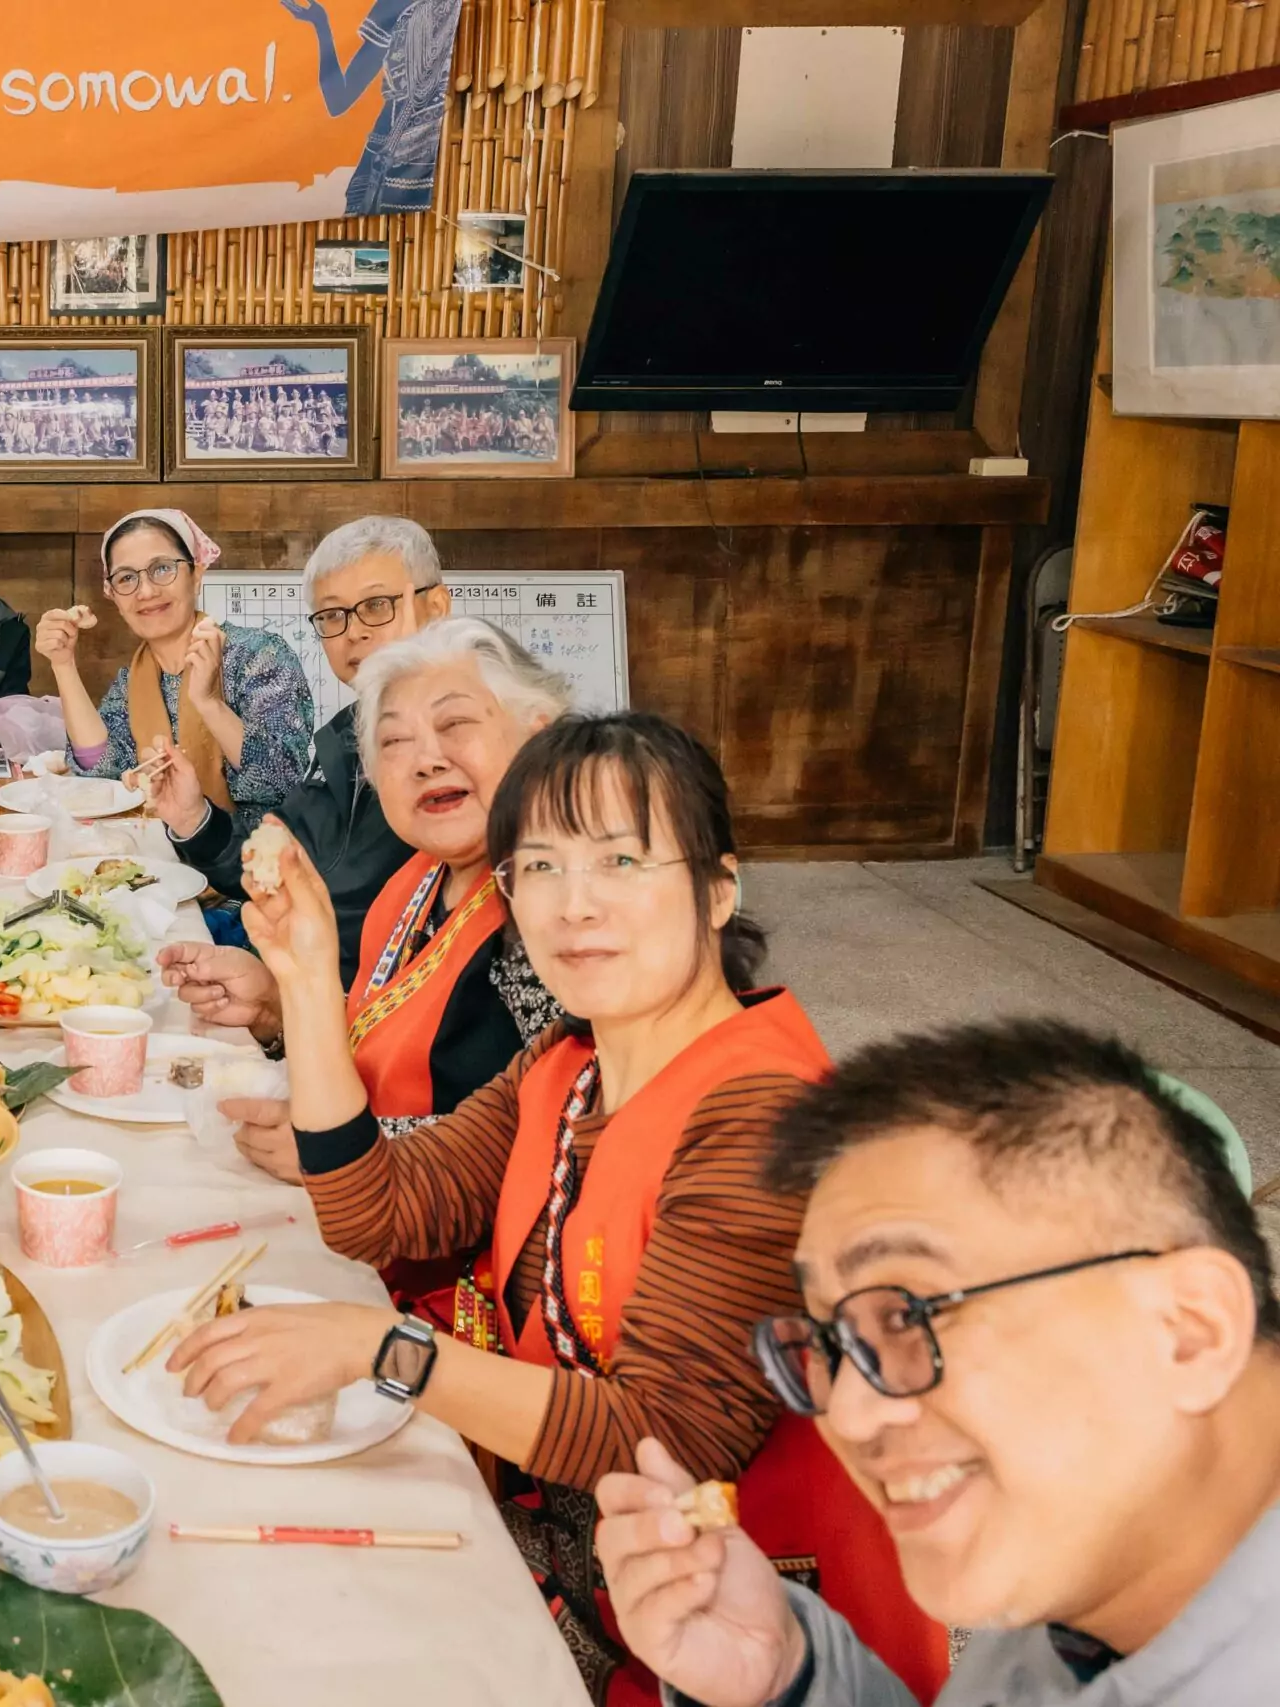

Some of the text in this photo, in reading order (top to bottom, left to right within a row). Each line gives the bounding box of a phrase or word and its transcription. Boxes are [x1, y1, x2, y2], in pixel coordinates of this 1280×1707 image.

[0, 41, 293, 116] somowal.
[251, 587, 517, 598] 1 2 3 12 13 14 15
[536, 592, 598, 608] 備註
